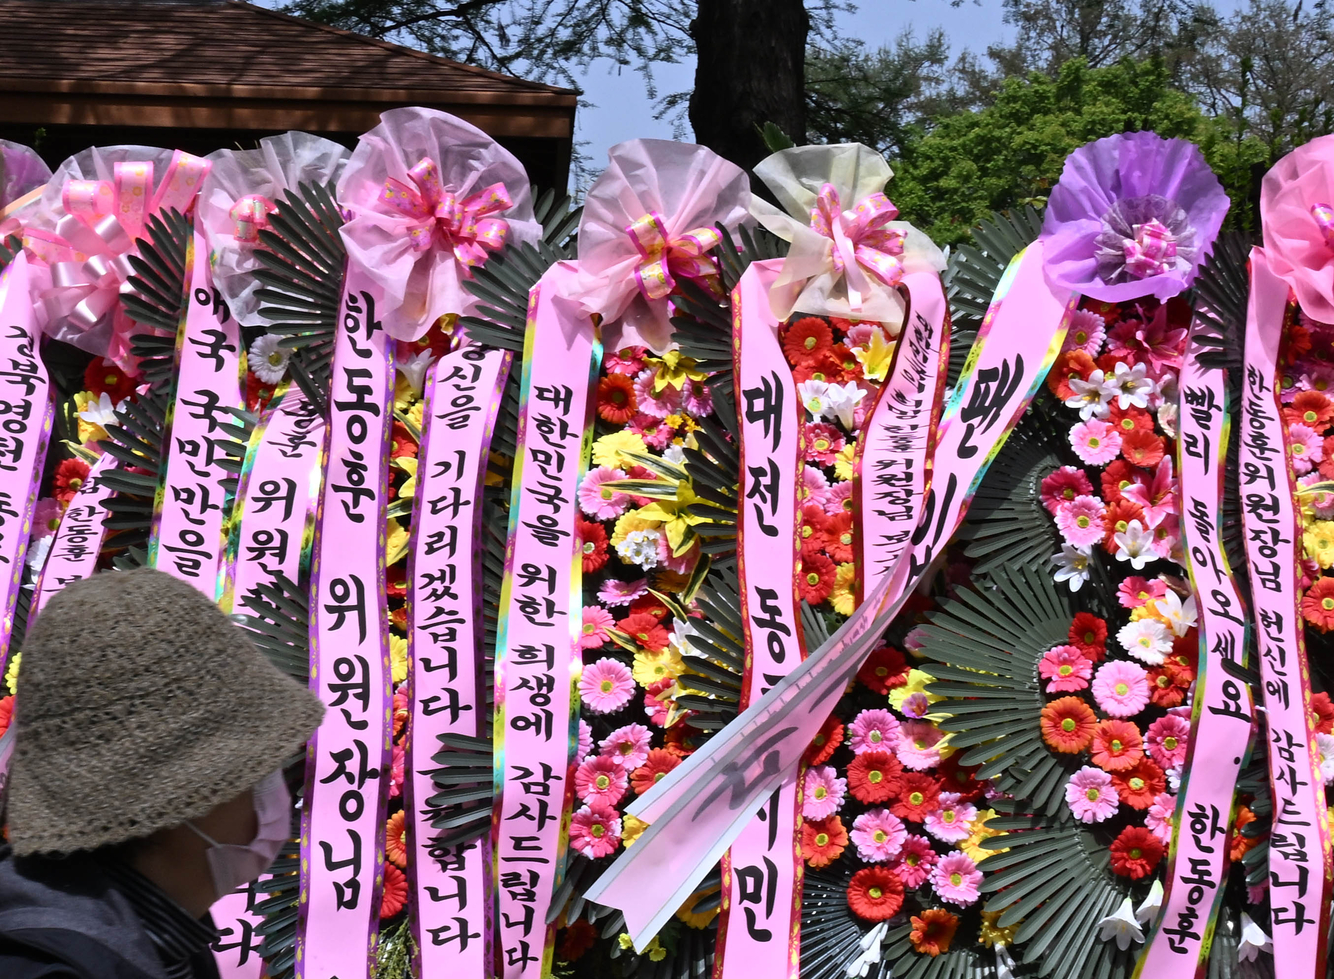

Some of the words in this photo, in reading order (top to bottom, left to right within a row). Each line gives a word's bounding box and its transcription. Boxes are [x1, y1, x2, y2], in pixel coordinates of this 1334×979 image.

[162, 389, 231, 578] 국민만을
[331, 290, 384, 524] 한동훈
[520, 383, 579, 548] 대한민국을
[741, 369, 786, 538] 대전
[870, 457, 924, 522] 위원장님
[1183, 384, 1216, 477] 빨리
[52, 504, 105, 562] 한동훈
[416, 450, 473, 725] 기다리겠습니다
[516, 562, 568, 628] 위한
[507, 642, 556, 743] 희생에
[1259, 606, 1291, 711] 헌신에
[317, 573, 380, 913] 위원장님
[499, 761, 564, 974] 감사드립니다
[1162, 802, 1226, 956] 한동훈
[1269, 727, 1317, 937] 감사드립니다
